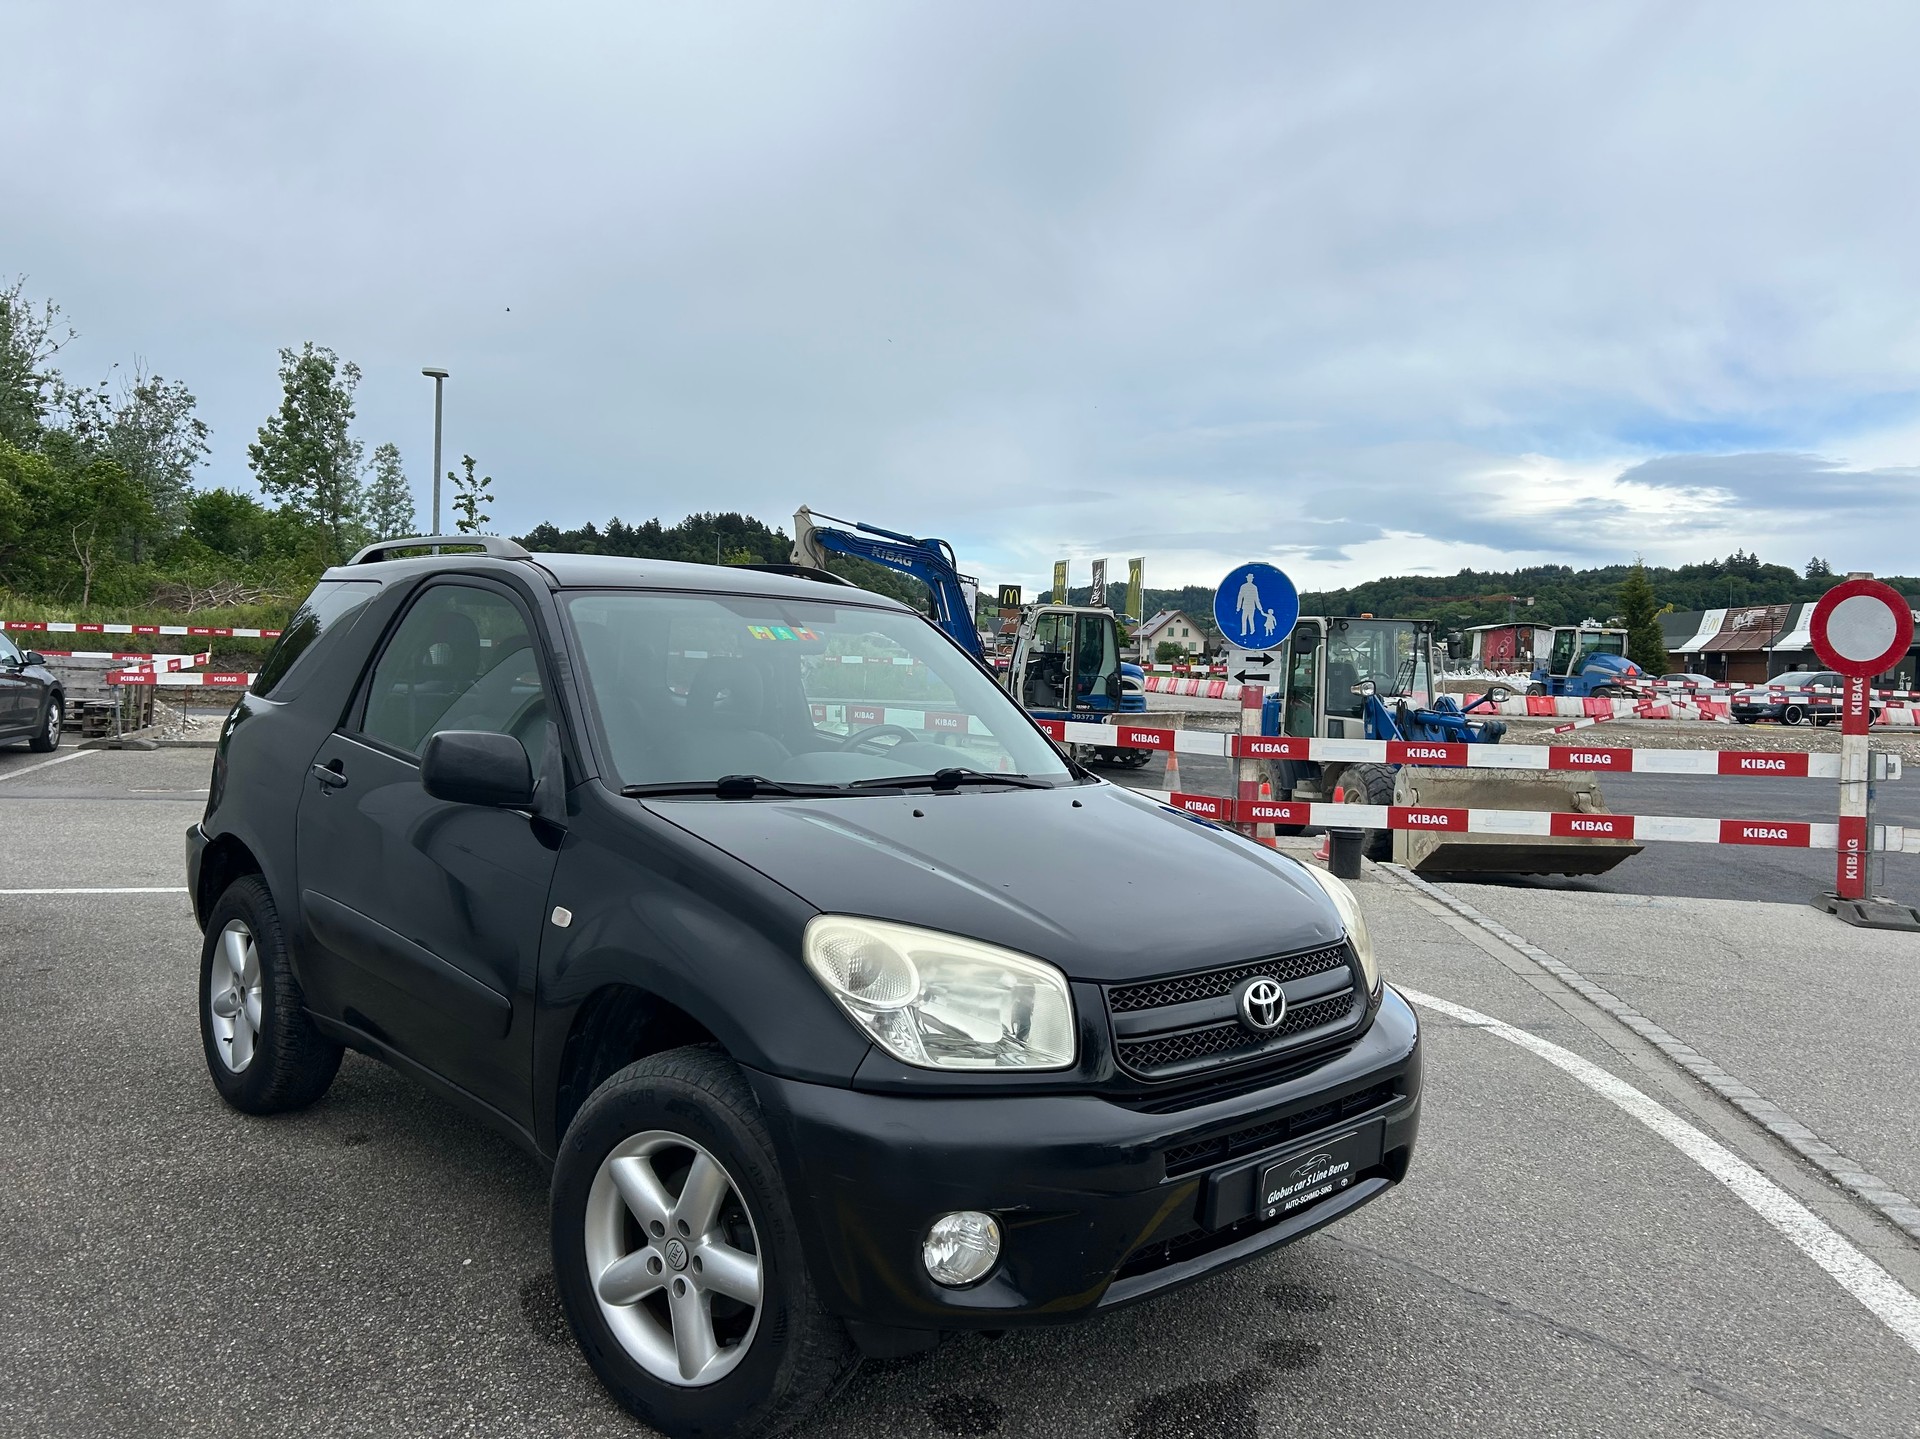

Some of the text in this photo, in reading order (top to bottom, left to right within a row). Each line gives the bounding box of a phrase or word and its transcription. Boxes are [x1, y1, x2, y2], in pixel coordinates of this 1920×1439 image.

[872, 546, 912, 567] KIBAG
[1851, 677, 1863, 715] KIBAG
[854, 711, 874, 719] KIBAG
[935, 718, 957, 727] KIBAG
[1131, 733, 1160, 744] KIBAG
[1251, 743, 1289, 753] KIBAG
[1407, 748, 1446, 758] KIBAG
[1570, 753, 1611, 764] KIBAG
[1741, 759, 1785, 770] KIBAG
[1185, 801, 1216, 812] KIBAG
[1252, 807, 1290, 818] KIBAG
[1408, 814, 1448, 824] KIBAG
[1571, 821, 1613, 831] KIBAG
[1743, 828, 1788, 839] KIBAG
[1846, 838, 1858, 879] KIBAG
[1267, 1161, 1350, 1204] Globus car S Line Berro
[1284, 1184, 1333, 1210] AUTO-SCHMID-SINS
